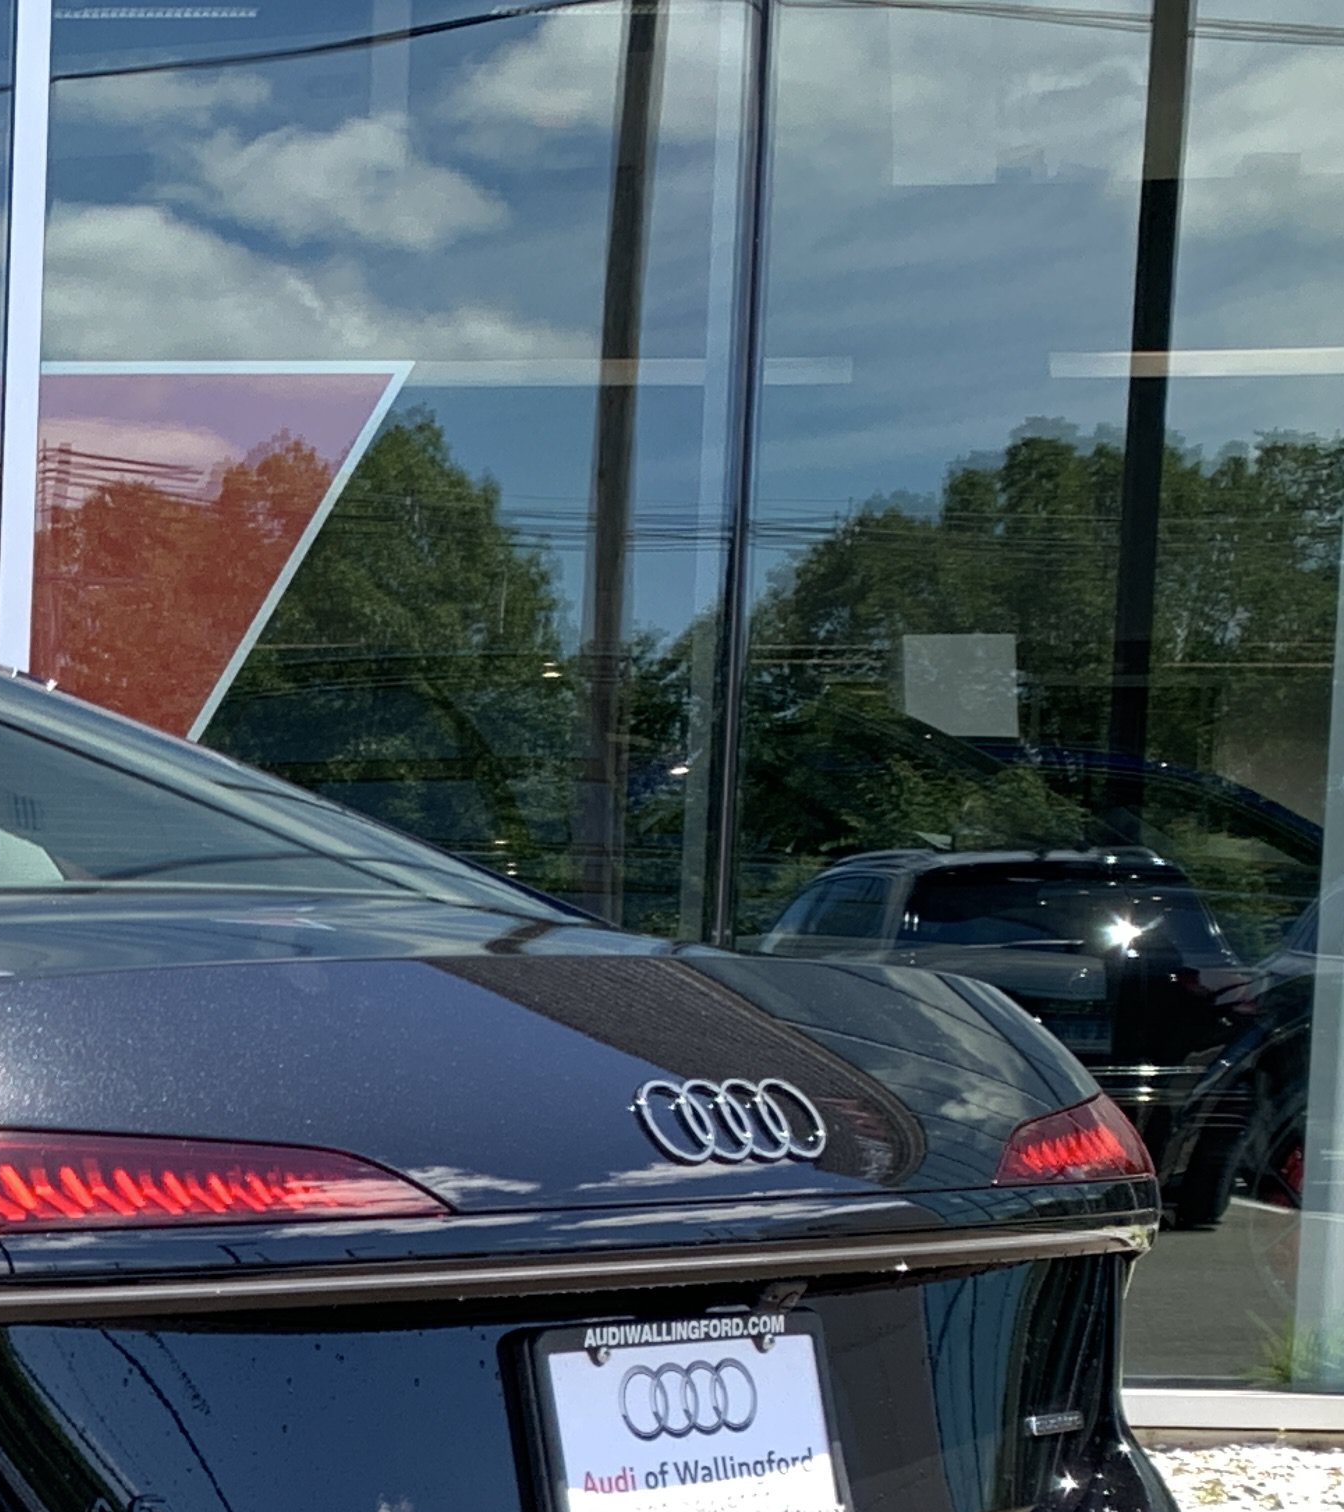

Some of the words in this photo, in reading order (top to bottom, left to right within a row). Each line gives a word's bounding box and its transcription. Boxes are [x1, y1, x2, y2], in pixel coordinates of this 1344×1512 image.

[584, 1314, 785, 1348] AUDIWALLINGFORD.COM
[583, 1467, 637, 1494] Audi
[645, 1461, 669, 1490] of
